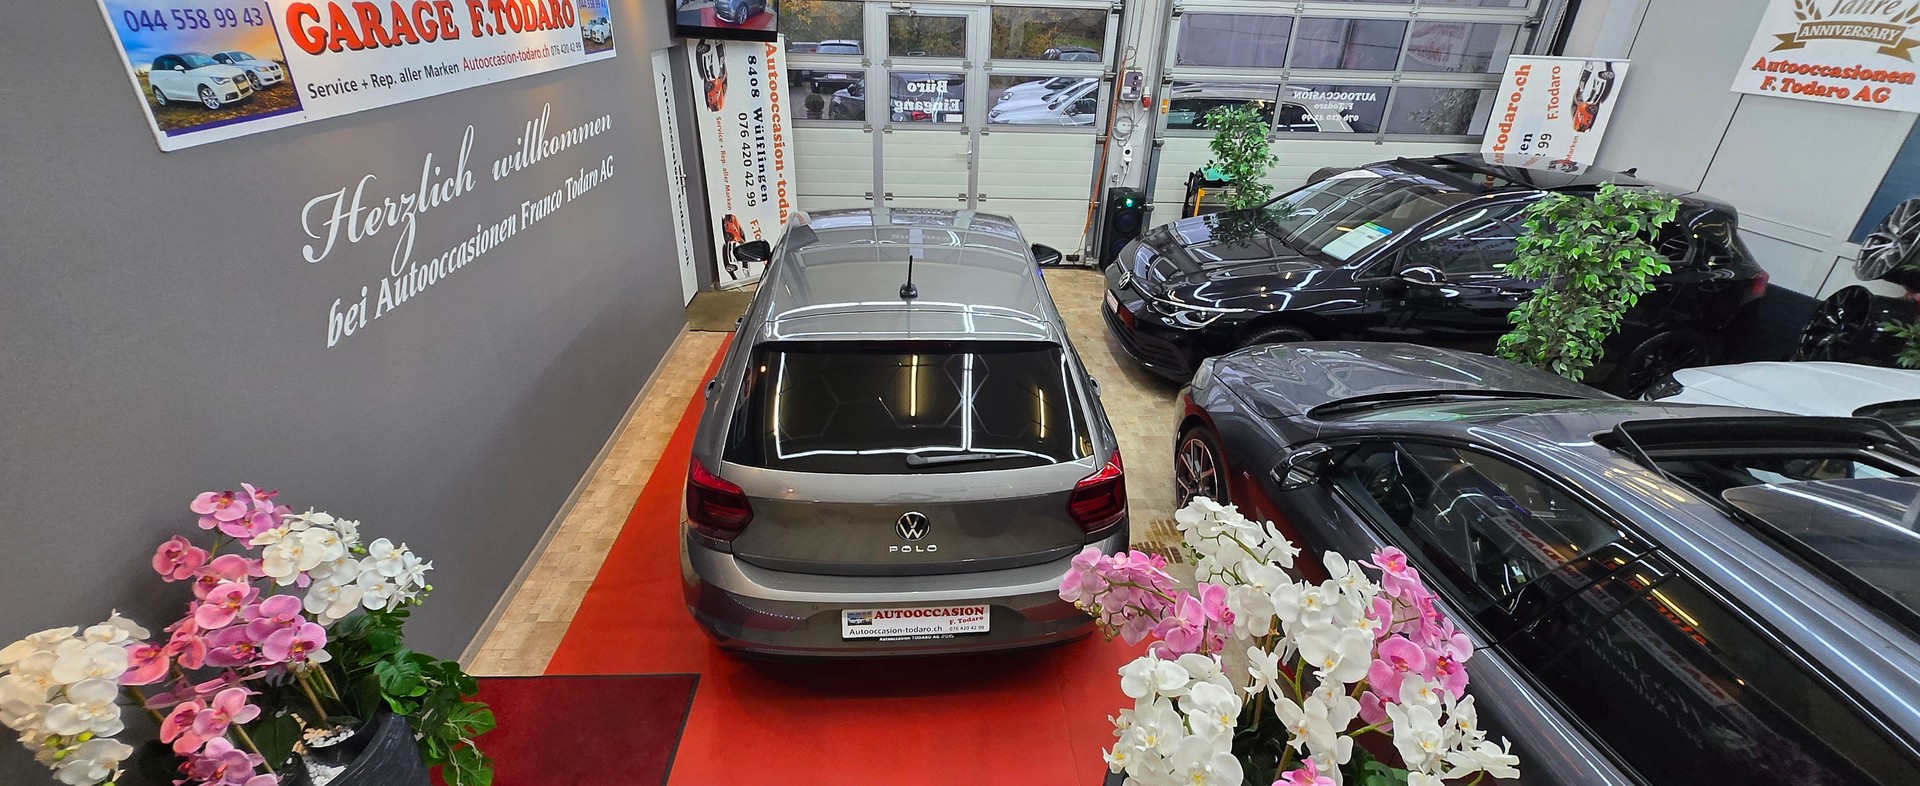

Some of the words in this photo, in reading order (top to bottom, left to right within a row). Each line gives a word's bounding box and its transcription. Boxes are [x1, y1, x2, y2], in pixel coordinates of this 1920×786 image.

[123, 9, 168, 33] 044
[172, 8, 211, 30] 558
[214, 7, 238, 28] 99
[243, 7, 264, 27] 43
[286, 0, 460, 55] GARAGE
[466, 0, 575, 38] F.TODARO
[1799, 25, 1902, 42] ANNIVERSARY
[307, 76, 359, 100] Service
[370, 73, 397, 90] Rep.
[399, 67, 423, 84] aller
[424, 63, 460, 80] Marken
[462, 44, 550, 72] Autooccasion-todaro.ch
[550, 44, 560, 56] 076
[561, 43, 570, 55] 420
[747, 54, 760, 98] 8408
[1751, 56, 1916, 85] Autooccasionen
[1547, 65, 1561, 121] F.Todaro
[1760, 75, 1776, 92] F.
[1780, 77, 1850, 99] Todaro
[1852, 86, 1892, 104] AG
[715, 116, 724, 143] Service
[738, 112, 749, 138] 076
[741, 142, 752, 166] 420
[1538, 133, 1552, 149] 99
[720, 150, 728, 166] Rep.
[752, 106, 768, 203] Wülflingen
[722, 167, 730, 184] aller
[745, 171, 755, 188] 42
[301, 124, 476, 277] Herzlich
[491, 102, 613, 181] willkommen
[724, 184, 732, 211] Marken
[746, 191, 756, 207] 99
[326, 285, 368, 349] bei
[373, 213, 517, 319] Autooccasionen
[520, 188, 563, 231] Franco
[564, 166, 598, 203] Todaro
[599, 155, 615, 184] AG
[889, 544, 938, 553] POLO
[874, 606, 985, 620] AUTOOCCASION
[957, 615, 984, 624] Todaro
[849, 625, 943, 636] Autooccasion-todaro.ch
